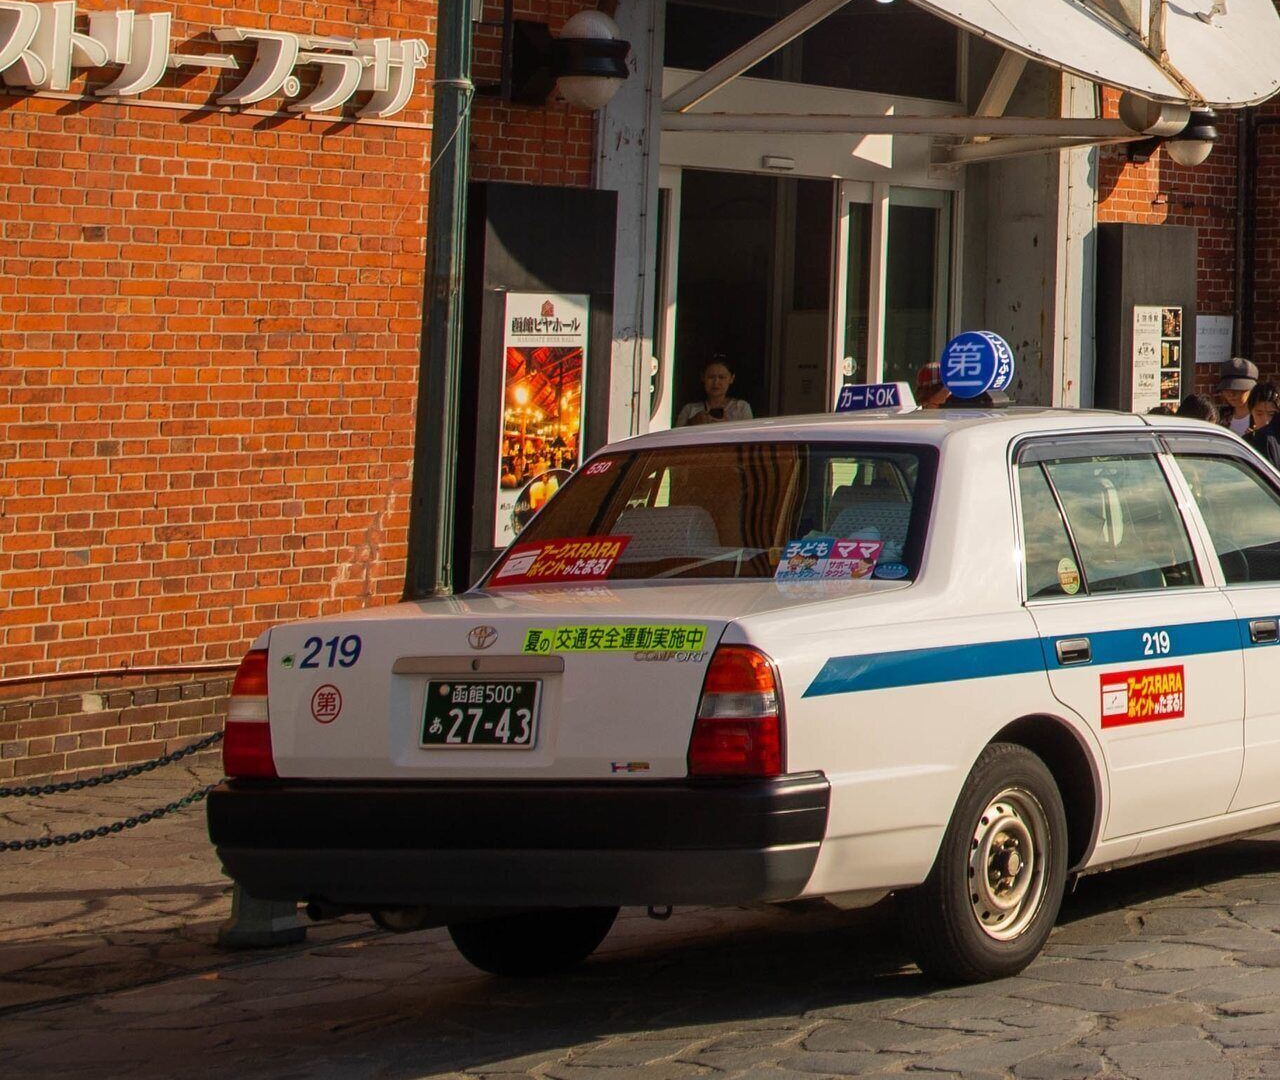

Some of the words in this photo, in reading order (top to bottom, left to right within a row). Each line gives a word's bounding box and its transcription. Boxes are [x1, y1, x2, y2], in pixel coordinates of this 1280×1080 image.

[512, 317, 581, 333] 函館ビヤホール
[946, 342, 985, 387] 第一
[841, 387, 895, 409] カードOK
[586, 461, 612, 474] 550
[537, 541, 622, 561] アークスRARA
[787, 542, 829, 557] 子ども
[837, 542, 880, 558] ママ
[555, 627, 704, 650] 交通安全運動実施中
[1142, 631, 1171, 656] 219
[299, 634, 362, 669] 219
[633, 650, 708, 663] COMFORT
[452, 685, 514, 703] 函館500
[1127, 672, 1183, 698] アークスRARA
[316, 692, 337, 717] 第一
[429, 716, 443, 735] あ
[446, 708, 531, 744] 27-43
